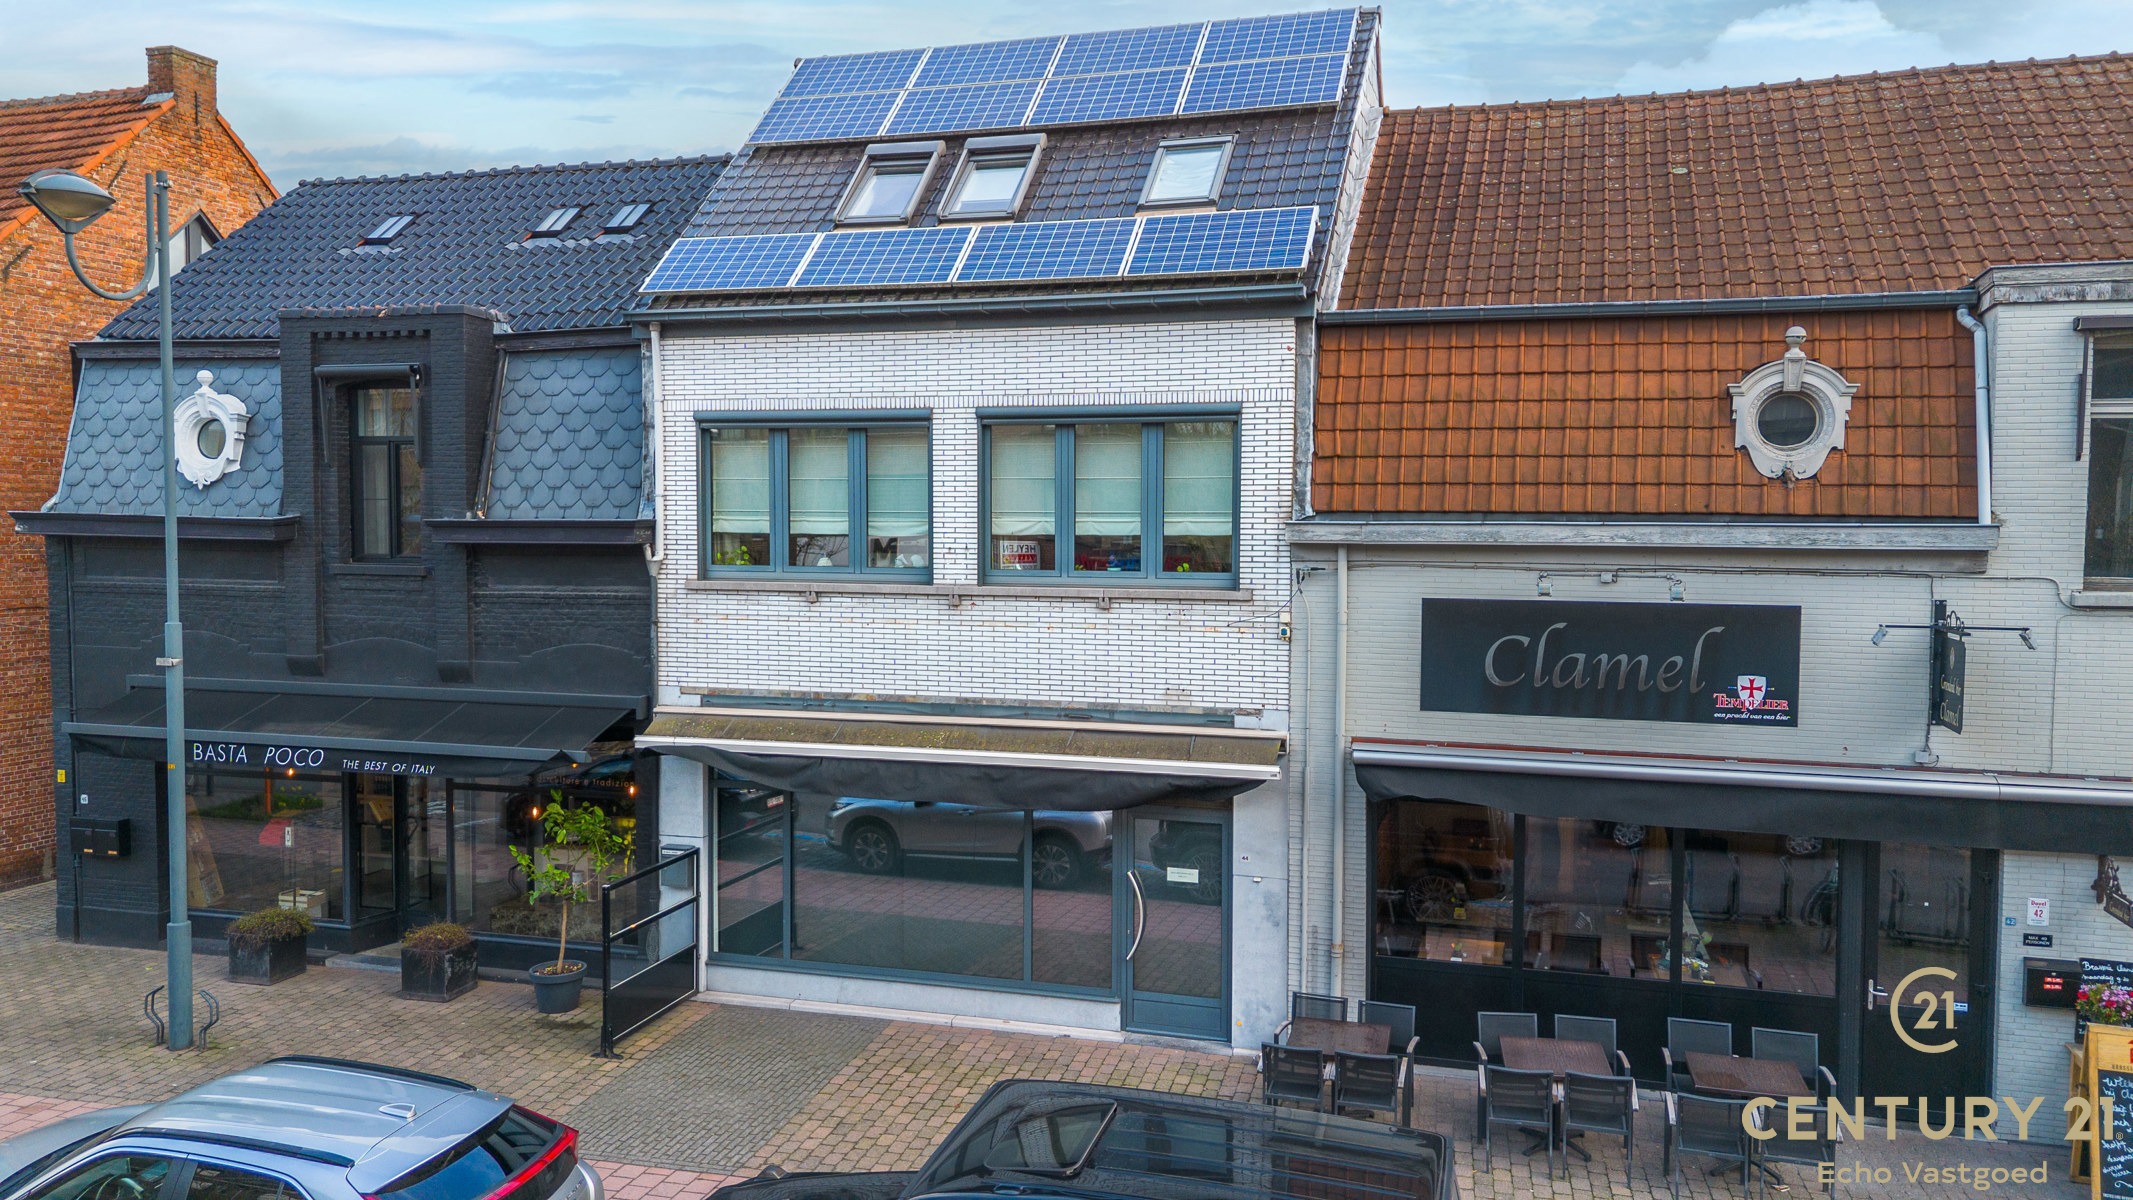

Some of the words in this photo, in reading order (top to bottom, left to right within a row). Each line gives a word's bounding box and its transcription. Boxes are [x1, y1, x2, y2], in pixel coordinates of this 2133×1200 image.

[1484, 622, 1725, 694] Clamel
[1713, 693, 1789, 711] TEMPELIER
[1725, 711, 1750, 720] pracht
[193, 743, 248, 763] BASTA
[264, 747, 324, 766] POCO
[343, 759, 360, 770] THE
[364, 761, 387, 771] BEST
[392, 763, 406, 773] OF
[410, 764, 436, 775] ITALY
[2034, 909, 2044, 918] 42
